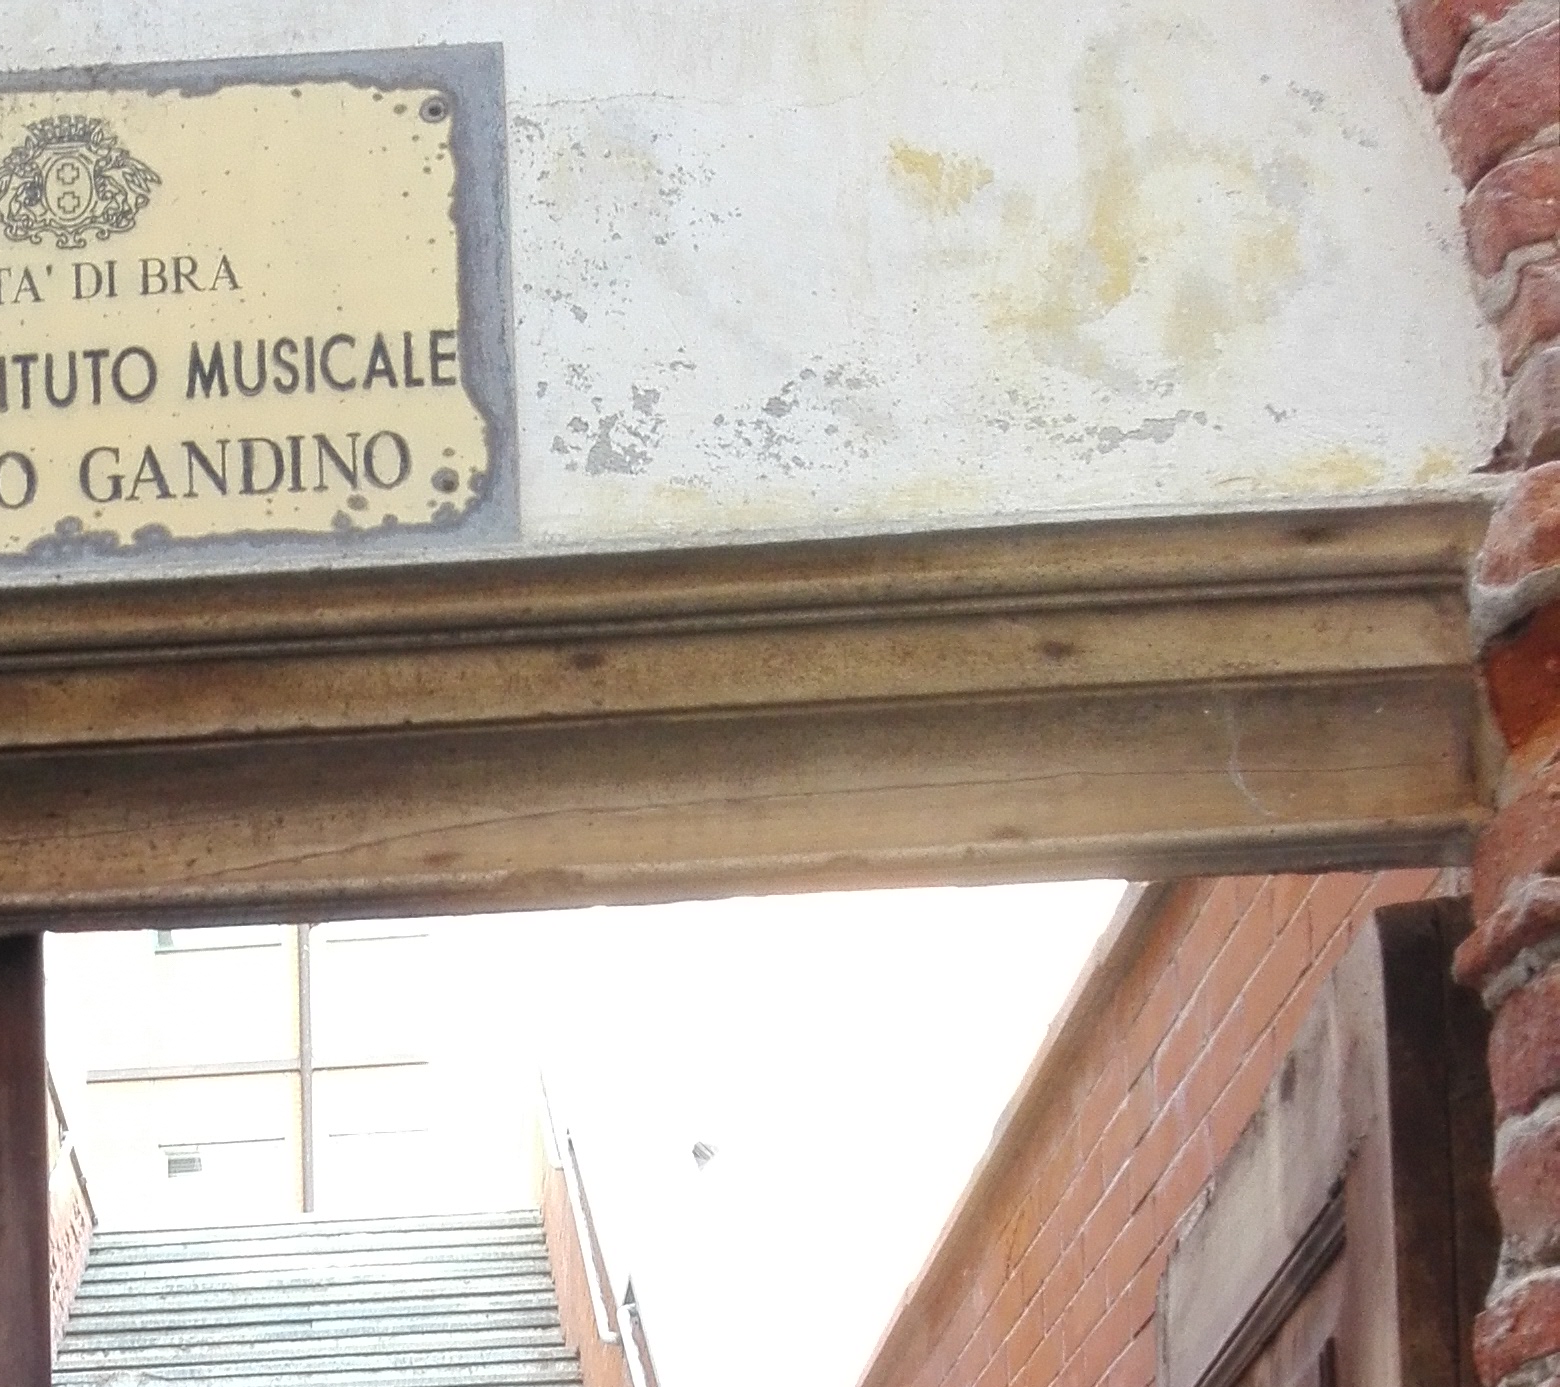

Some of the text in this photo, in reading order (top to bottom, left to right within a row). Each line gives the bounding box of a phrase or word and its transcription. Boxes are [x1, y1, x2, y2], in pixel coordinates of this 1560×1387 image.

[73, 261, 119, 299] DI
[140, 255, 243, 296] BRA
[186, 329, 458, 401] MUSICALE
[78, 430, 413, 503] GANDINO
